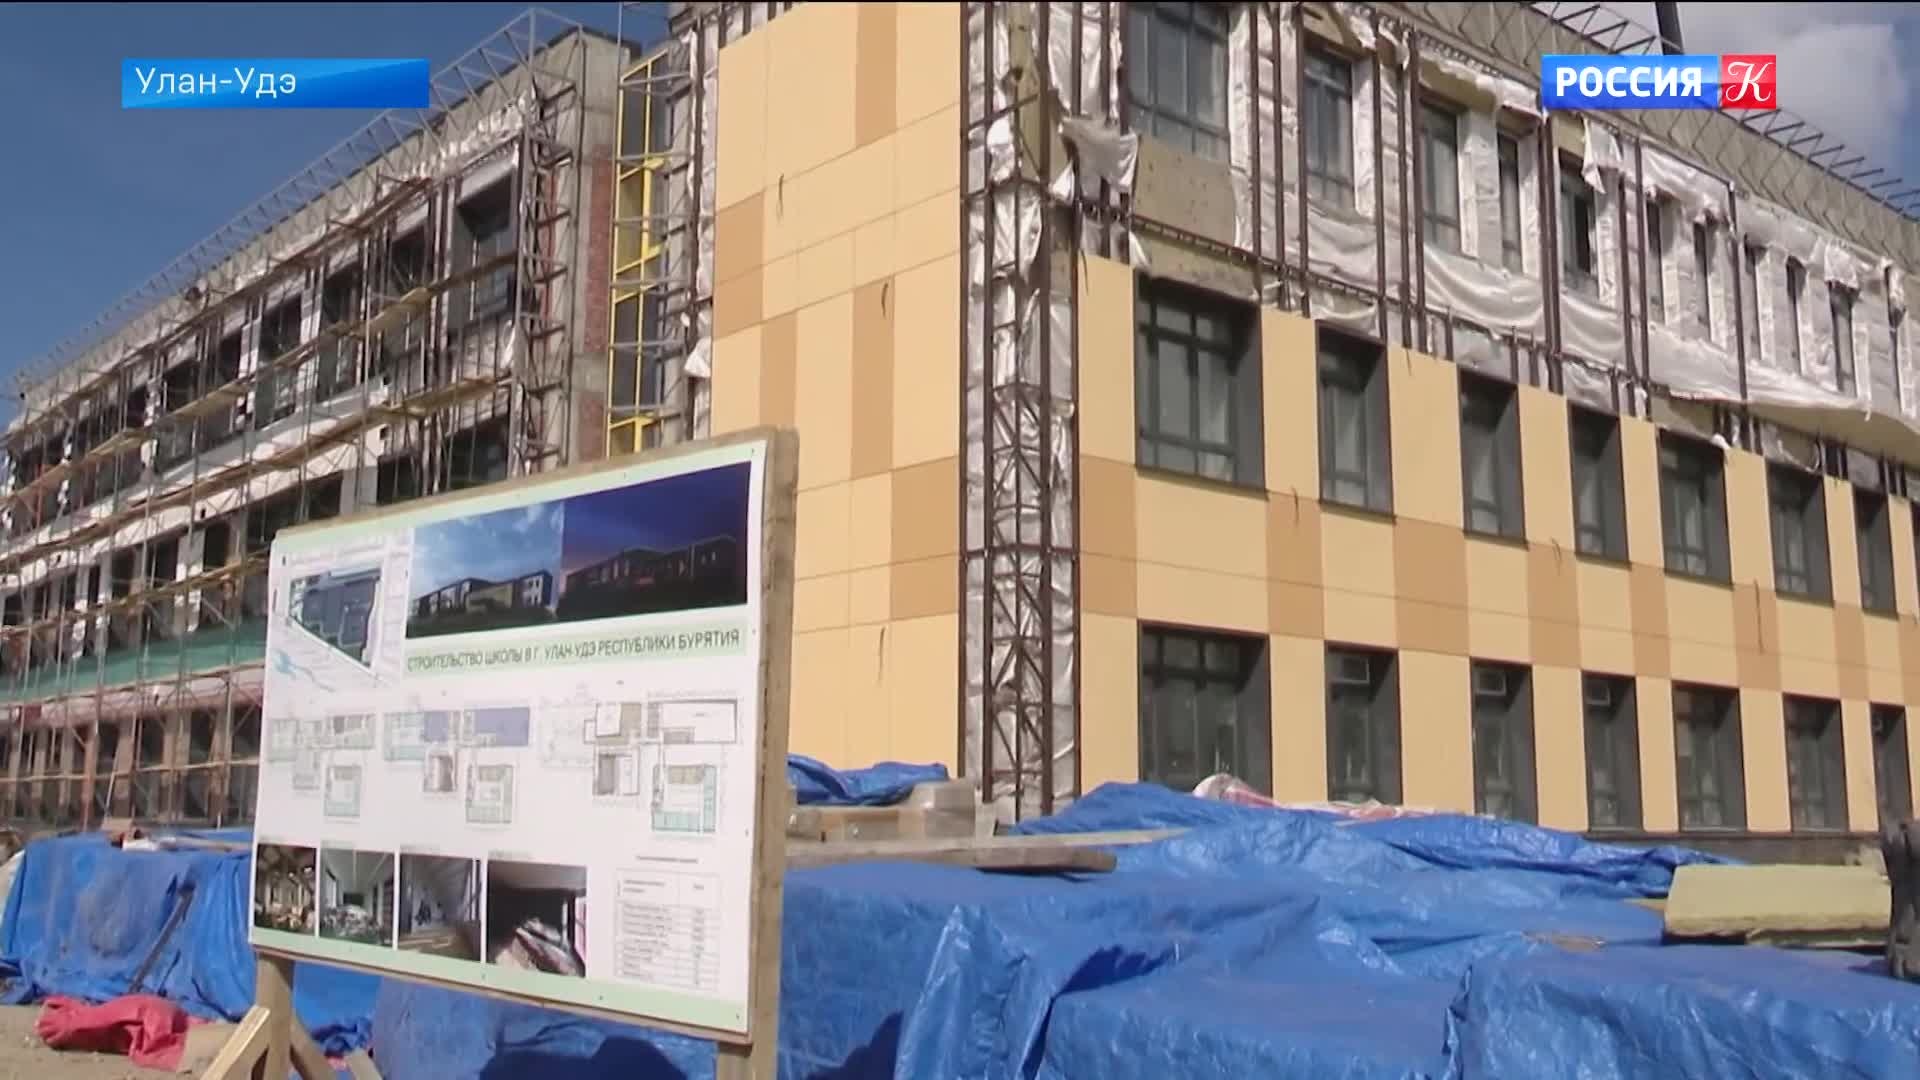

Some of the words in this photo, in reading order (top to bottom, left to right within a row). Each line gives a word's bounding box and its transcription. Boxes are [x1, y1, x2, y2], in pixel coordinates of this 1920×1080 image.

[485, 648, 522, 665] ШКОЛЫ
[598, 634, 675, 656] РЕСПУБЛИКИ
[679, 629, 739, 649] БУРЯТИЯ
